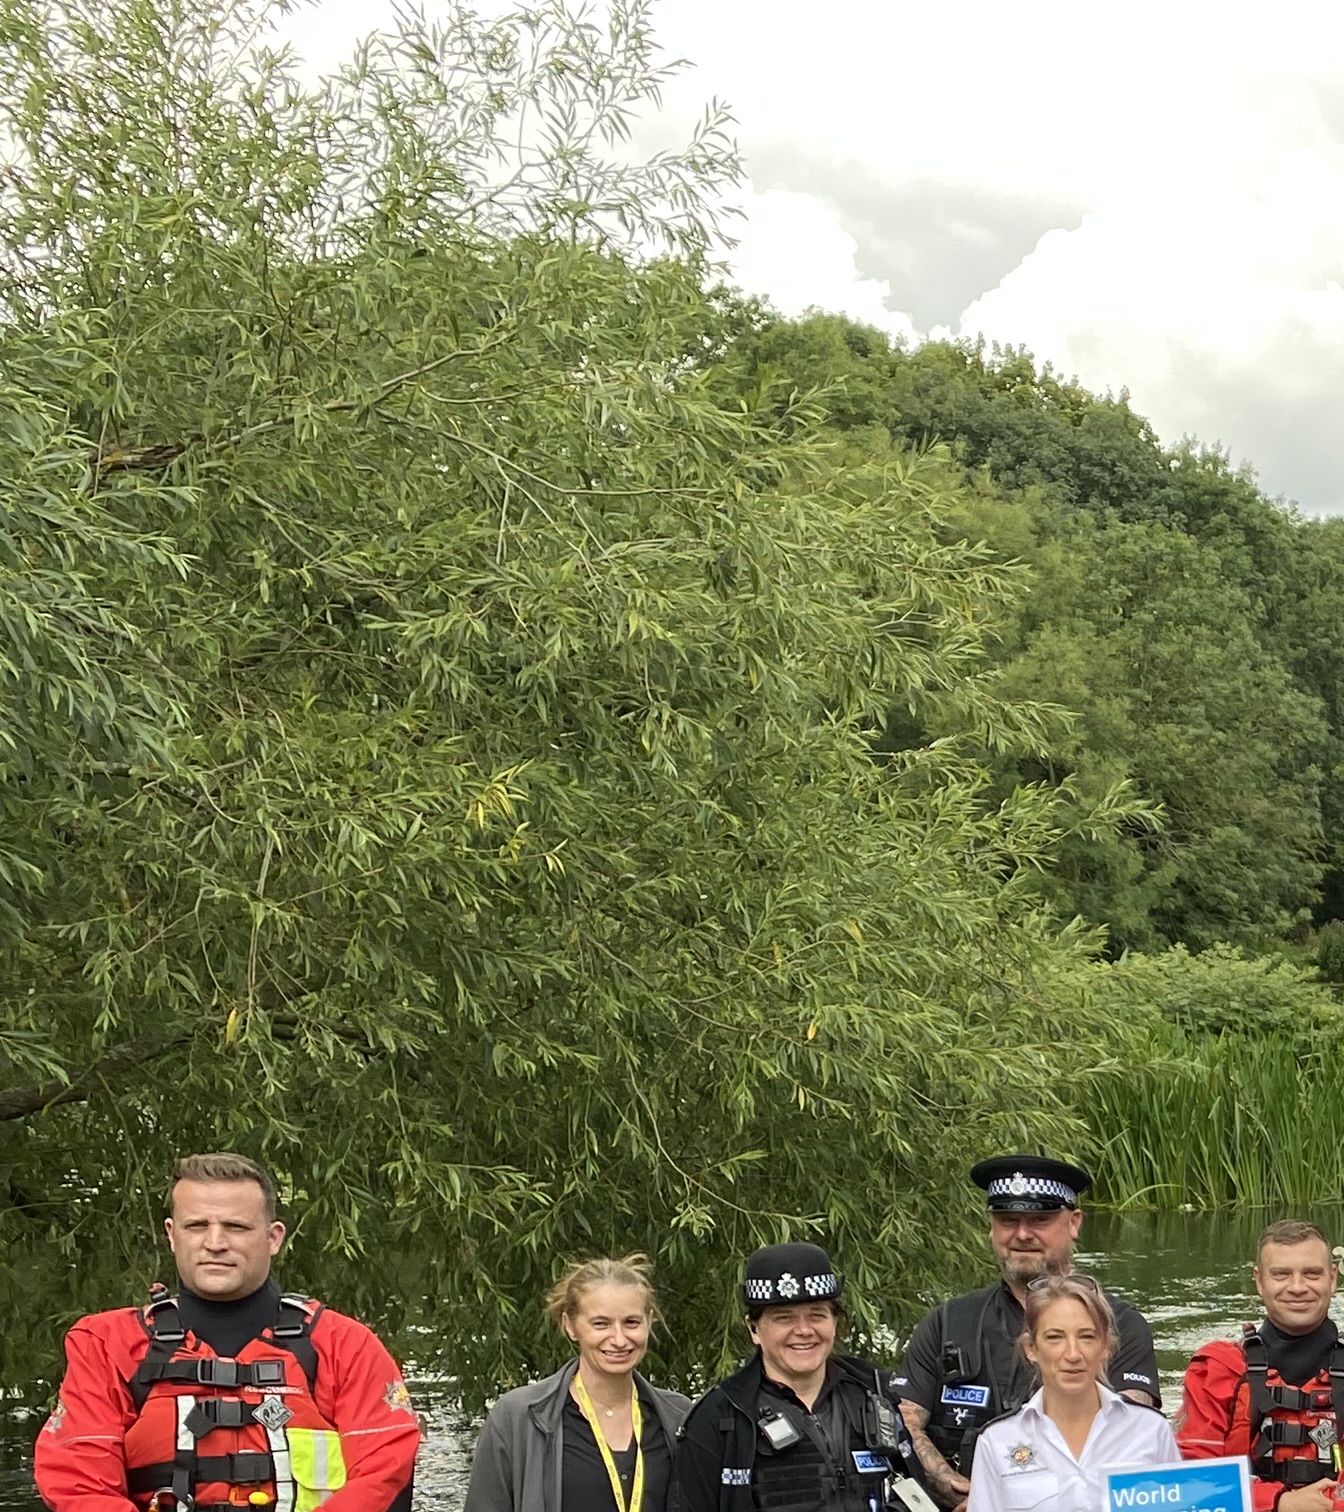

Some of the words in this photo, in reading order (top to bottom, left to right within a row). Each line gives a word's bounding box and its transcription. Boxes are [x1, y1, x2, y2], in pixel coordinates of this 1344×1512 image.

[946, 1388, 983, 1402] POLICE
[857, 1455, 884, 1467] POLIC
[1112, 1484, 1180, 1507] World
